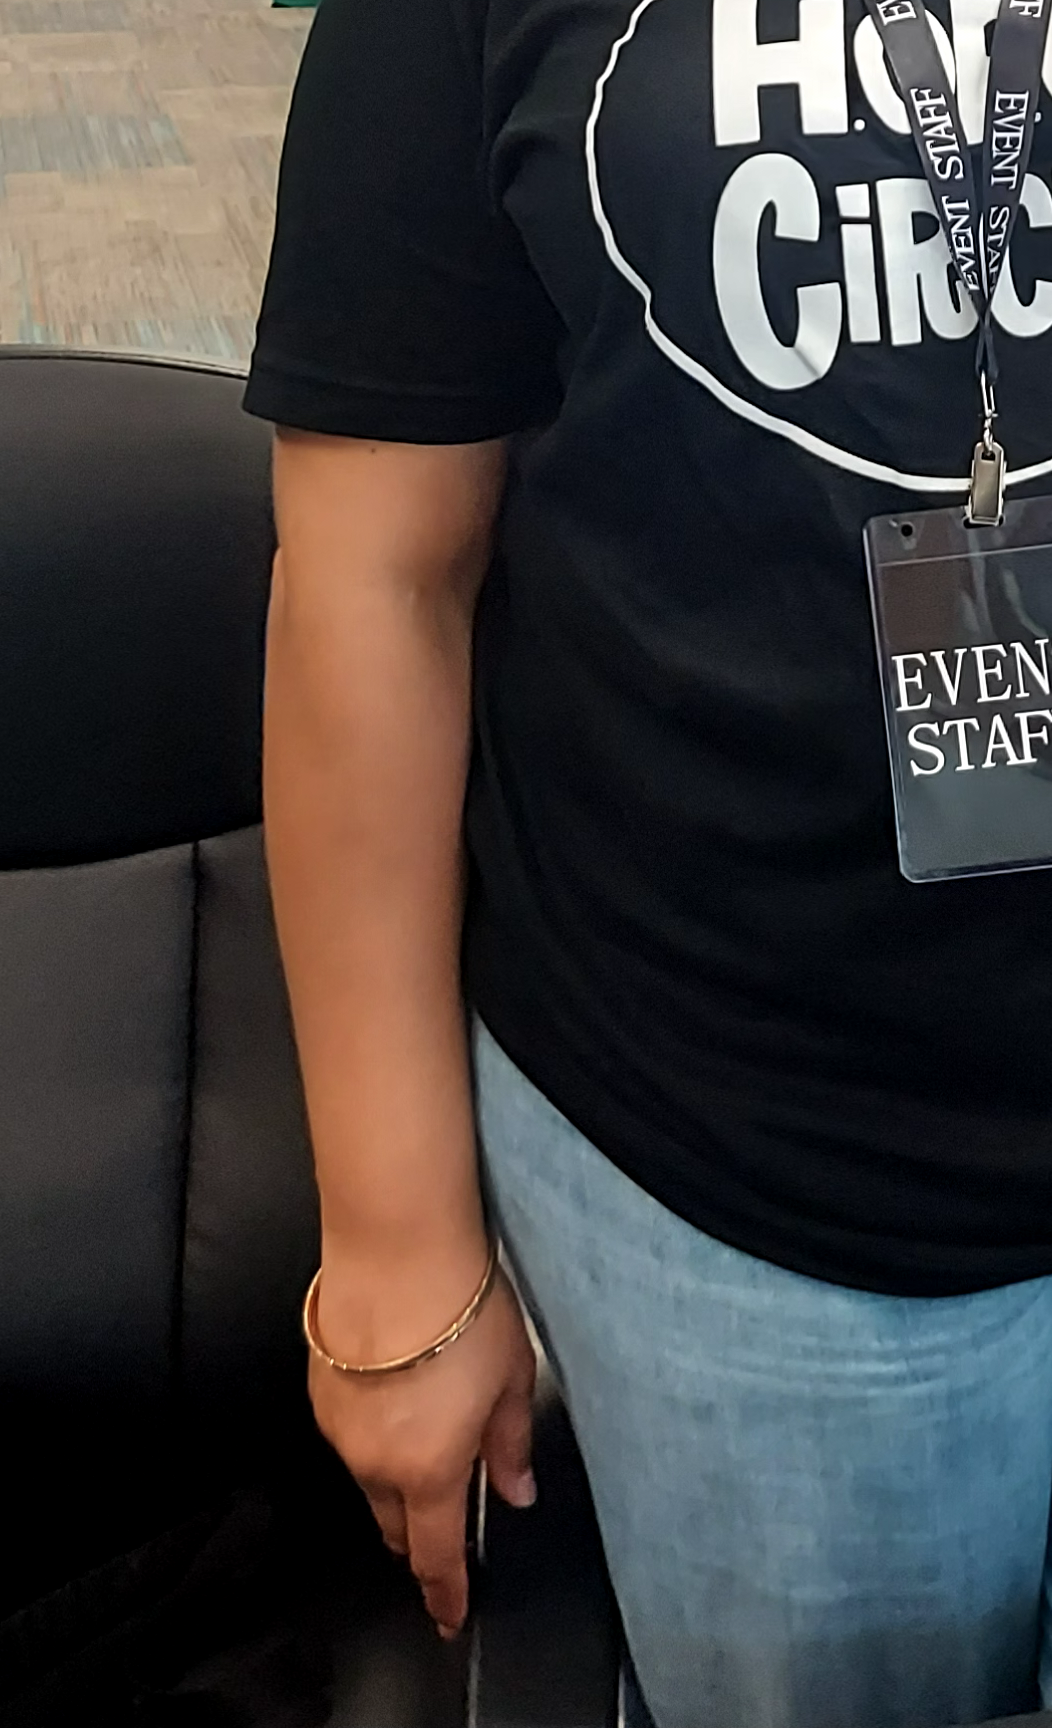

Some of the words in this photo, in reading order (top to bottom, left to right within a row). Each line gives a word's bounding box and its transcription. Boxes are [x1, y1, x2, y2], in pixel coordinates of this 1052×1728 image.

[910, 88, 965, 181] STAFF
[990, 90, 1030, 190] EVENT
[941, 195, 980, 291] EVENT
[986, 206, 1010, 293] STAF
